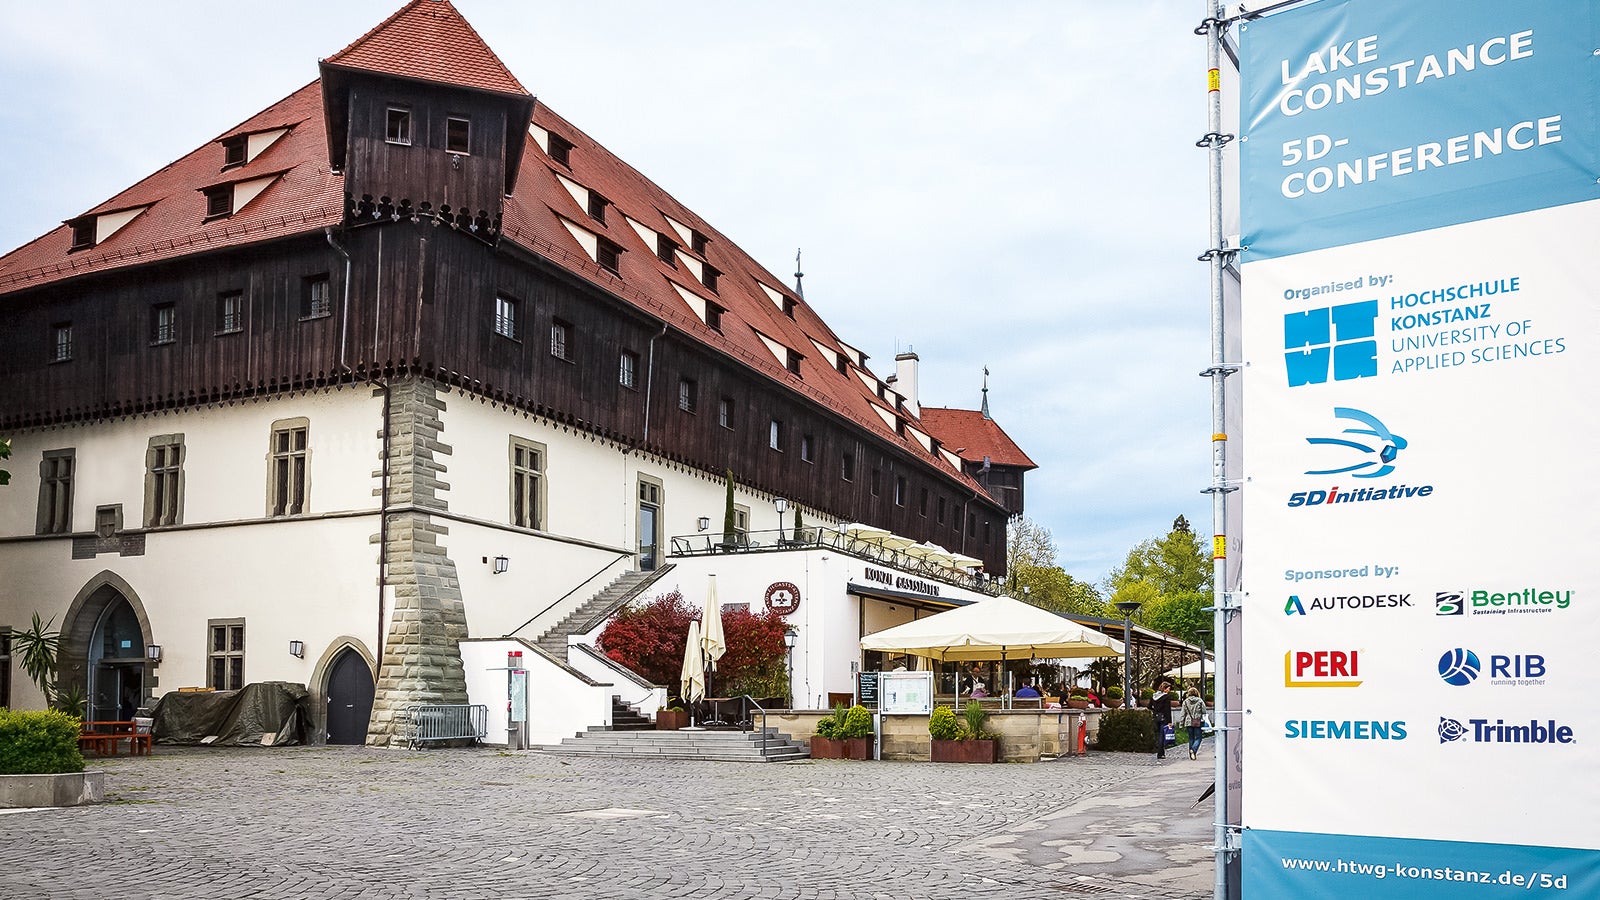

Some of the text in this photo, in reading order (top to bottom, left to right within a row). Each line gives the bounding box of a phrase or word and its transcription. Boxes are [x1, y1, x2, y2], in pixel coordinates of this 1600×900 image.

[1280, 34, 1378, 86] LAKE
[1280, 29, 1534, 117] CONSTANCE
[1281, 133, 1350, 167] 5D-
[1281, 114, 1562, 199] CONFERENCE
[1283, 272, 1394, 300] Organised by:
[1391, 276, 1520, 310] HOCHSCHULE
[1391, 303, 1492, 331] KONSTANZ
[1391, 319, 1532, 353] UNIVERSITY OF
[1391, 337, 1566, 374] APPLIED SCIENCES
[1284, 564, 1399, 583] Sponsored by:
[1310, 594, 1411, 610] AUTODESK
[1471, 588, 1570, 609] Bentley
[1296, 650, 1358, 677] PERI
[1491, 654, 1546, 678] RIB
[1517, 679, 1546, 687] together
[1285, 720, 1407, 740] SIEMENS
[1469, 719, 1573, 743] Trimble
[1281, 857, 1567, 889] www.htwg-konstanz.de/5d
